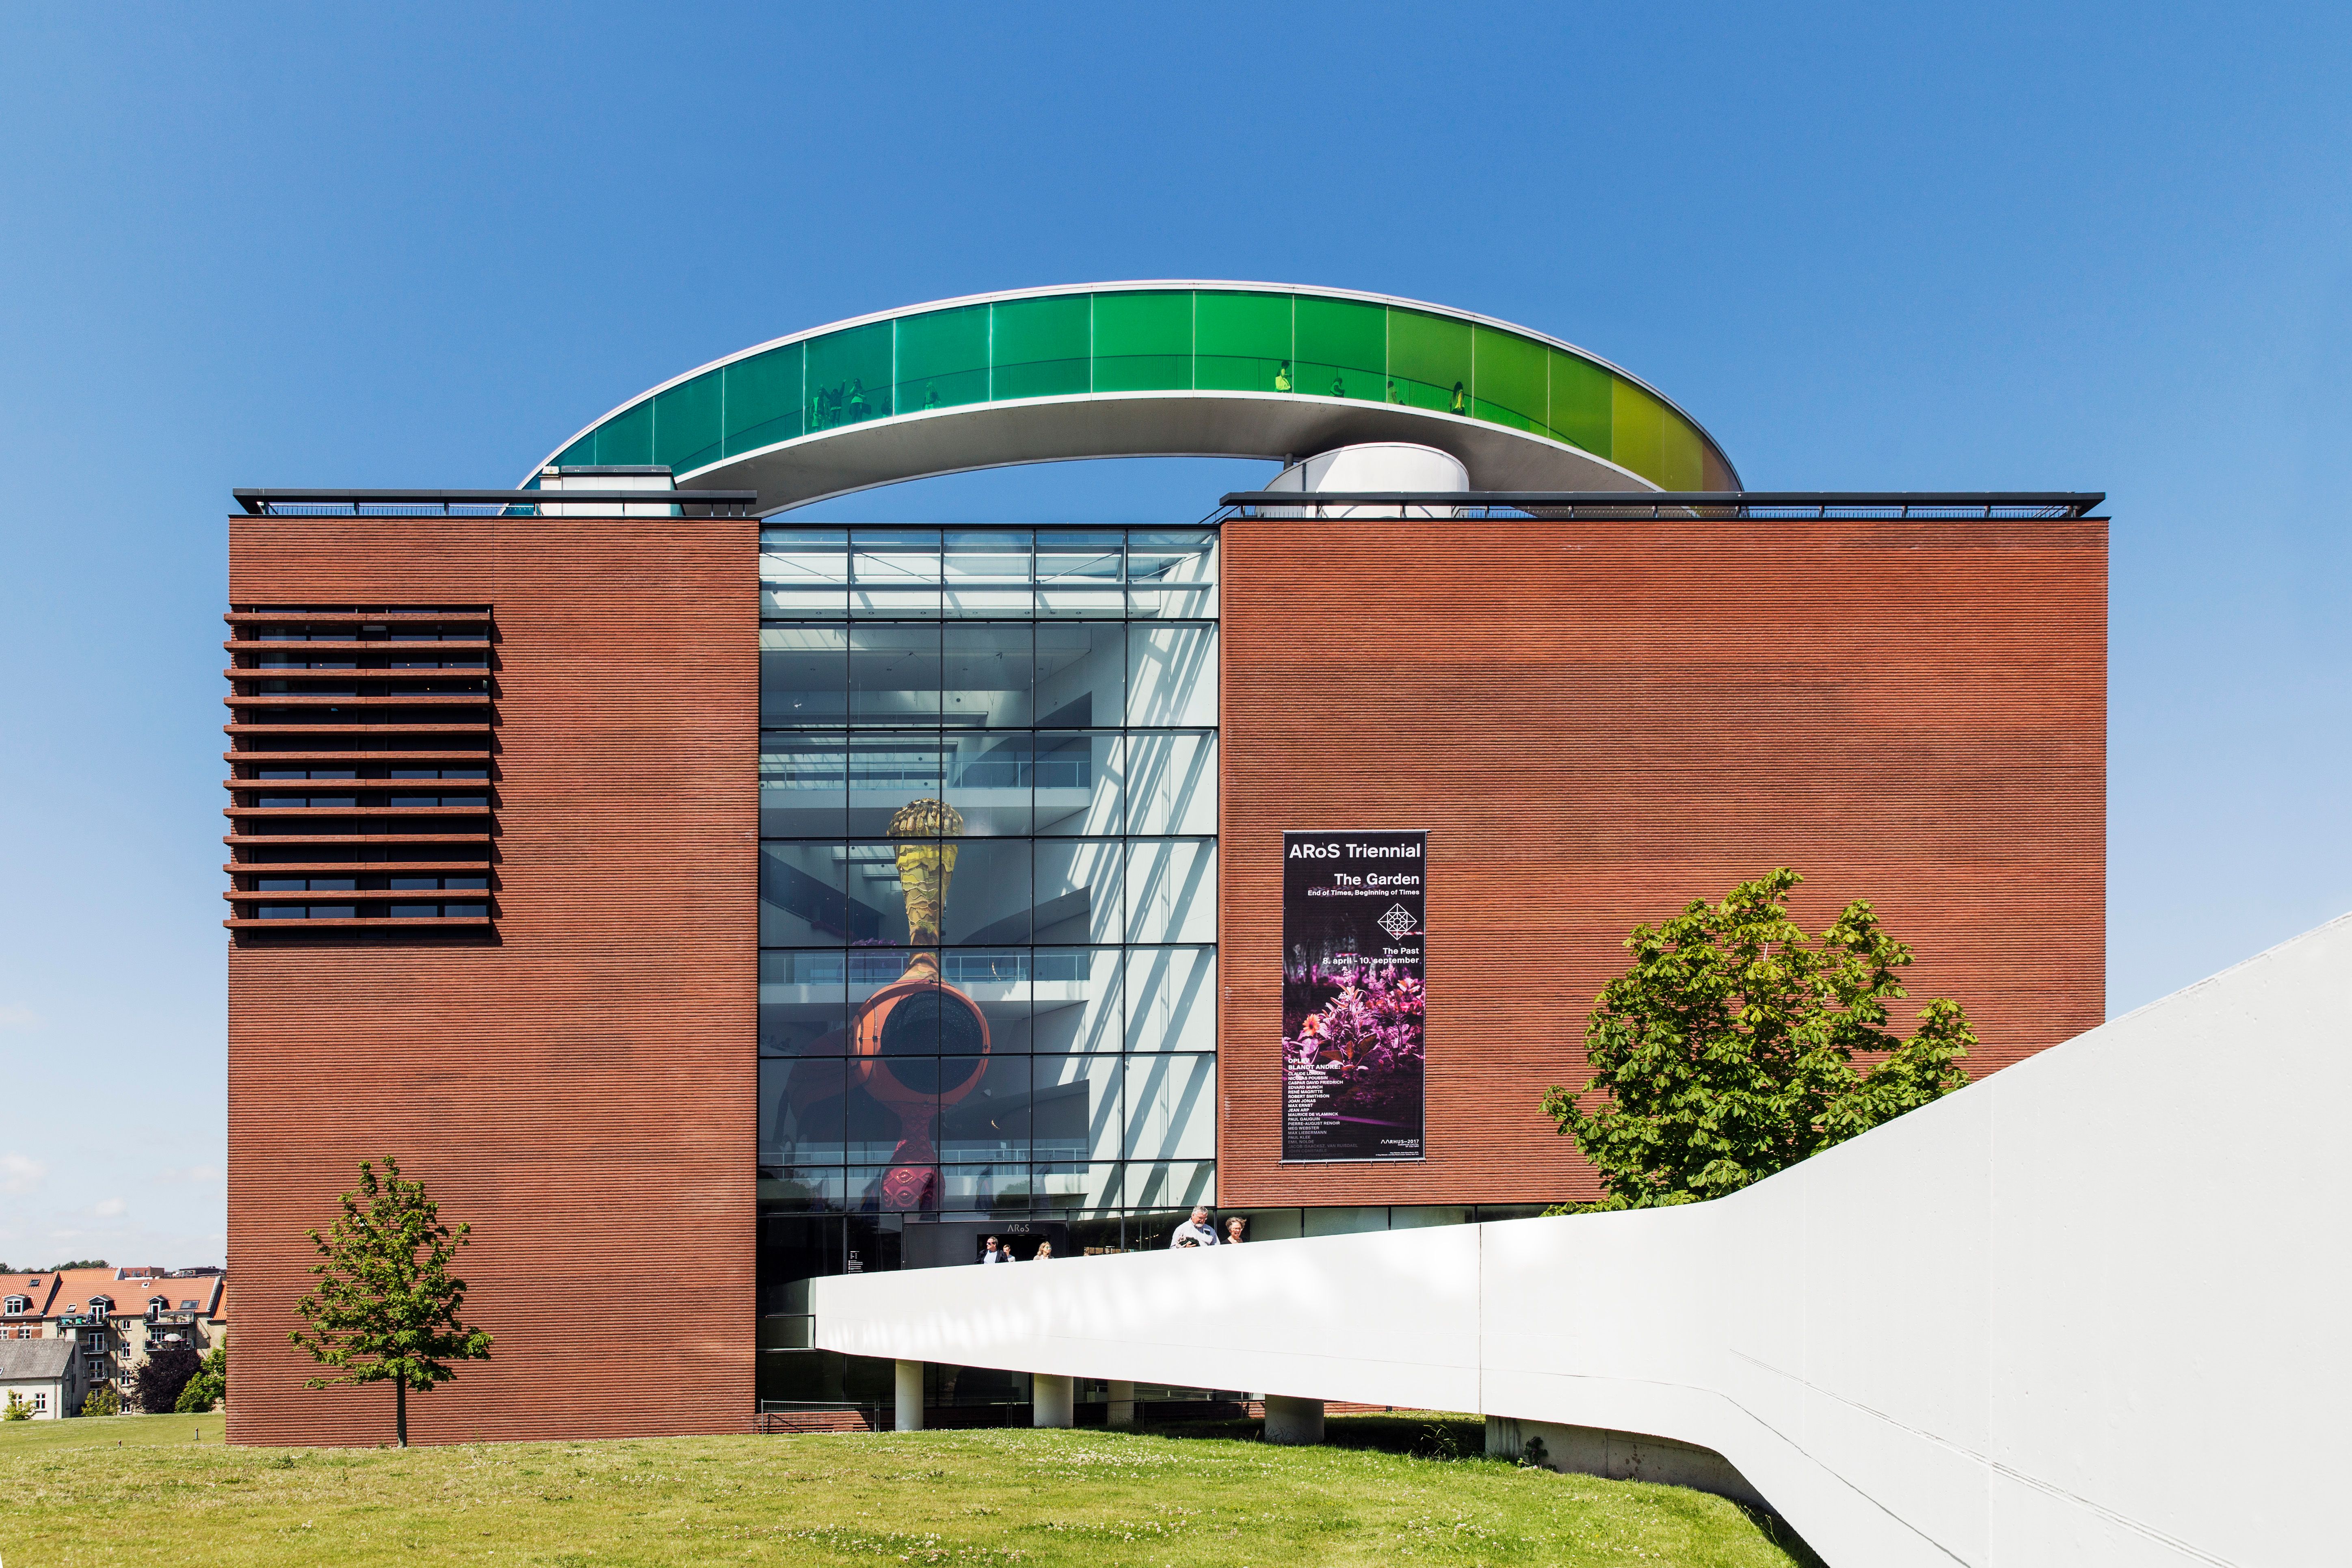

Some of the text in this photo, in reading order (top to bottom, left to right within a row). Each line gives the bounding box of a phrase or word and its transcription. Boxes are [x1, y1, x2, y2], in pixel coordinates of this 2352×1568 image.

[1289, 843, 1420, 858] ARoS Triennial
[1334, 873, 1419, 885] The Garden
